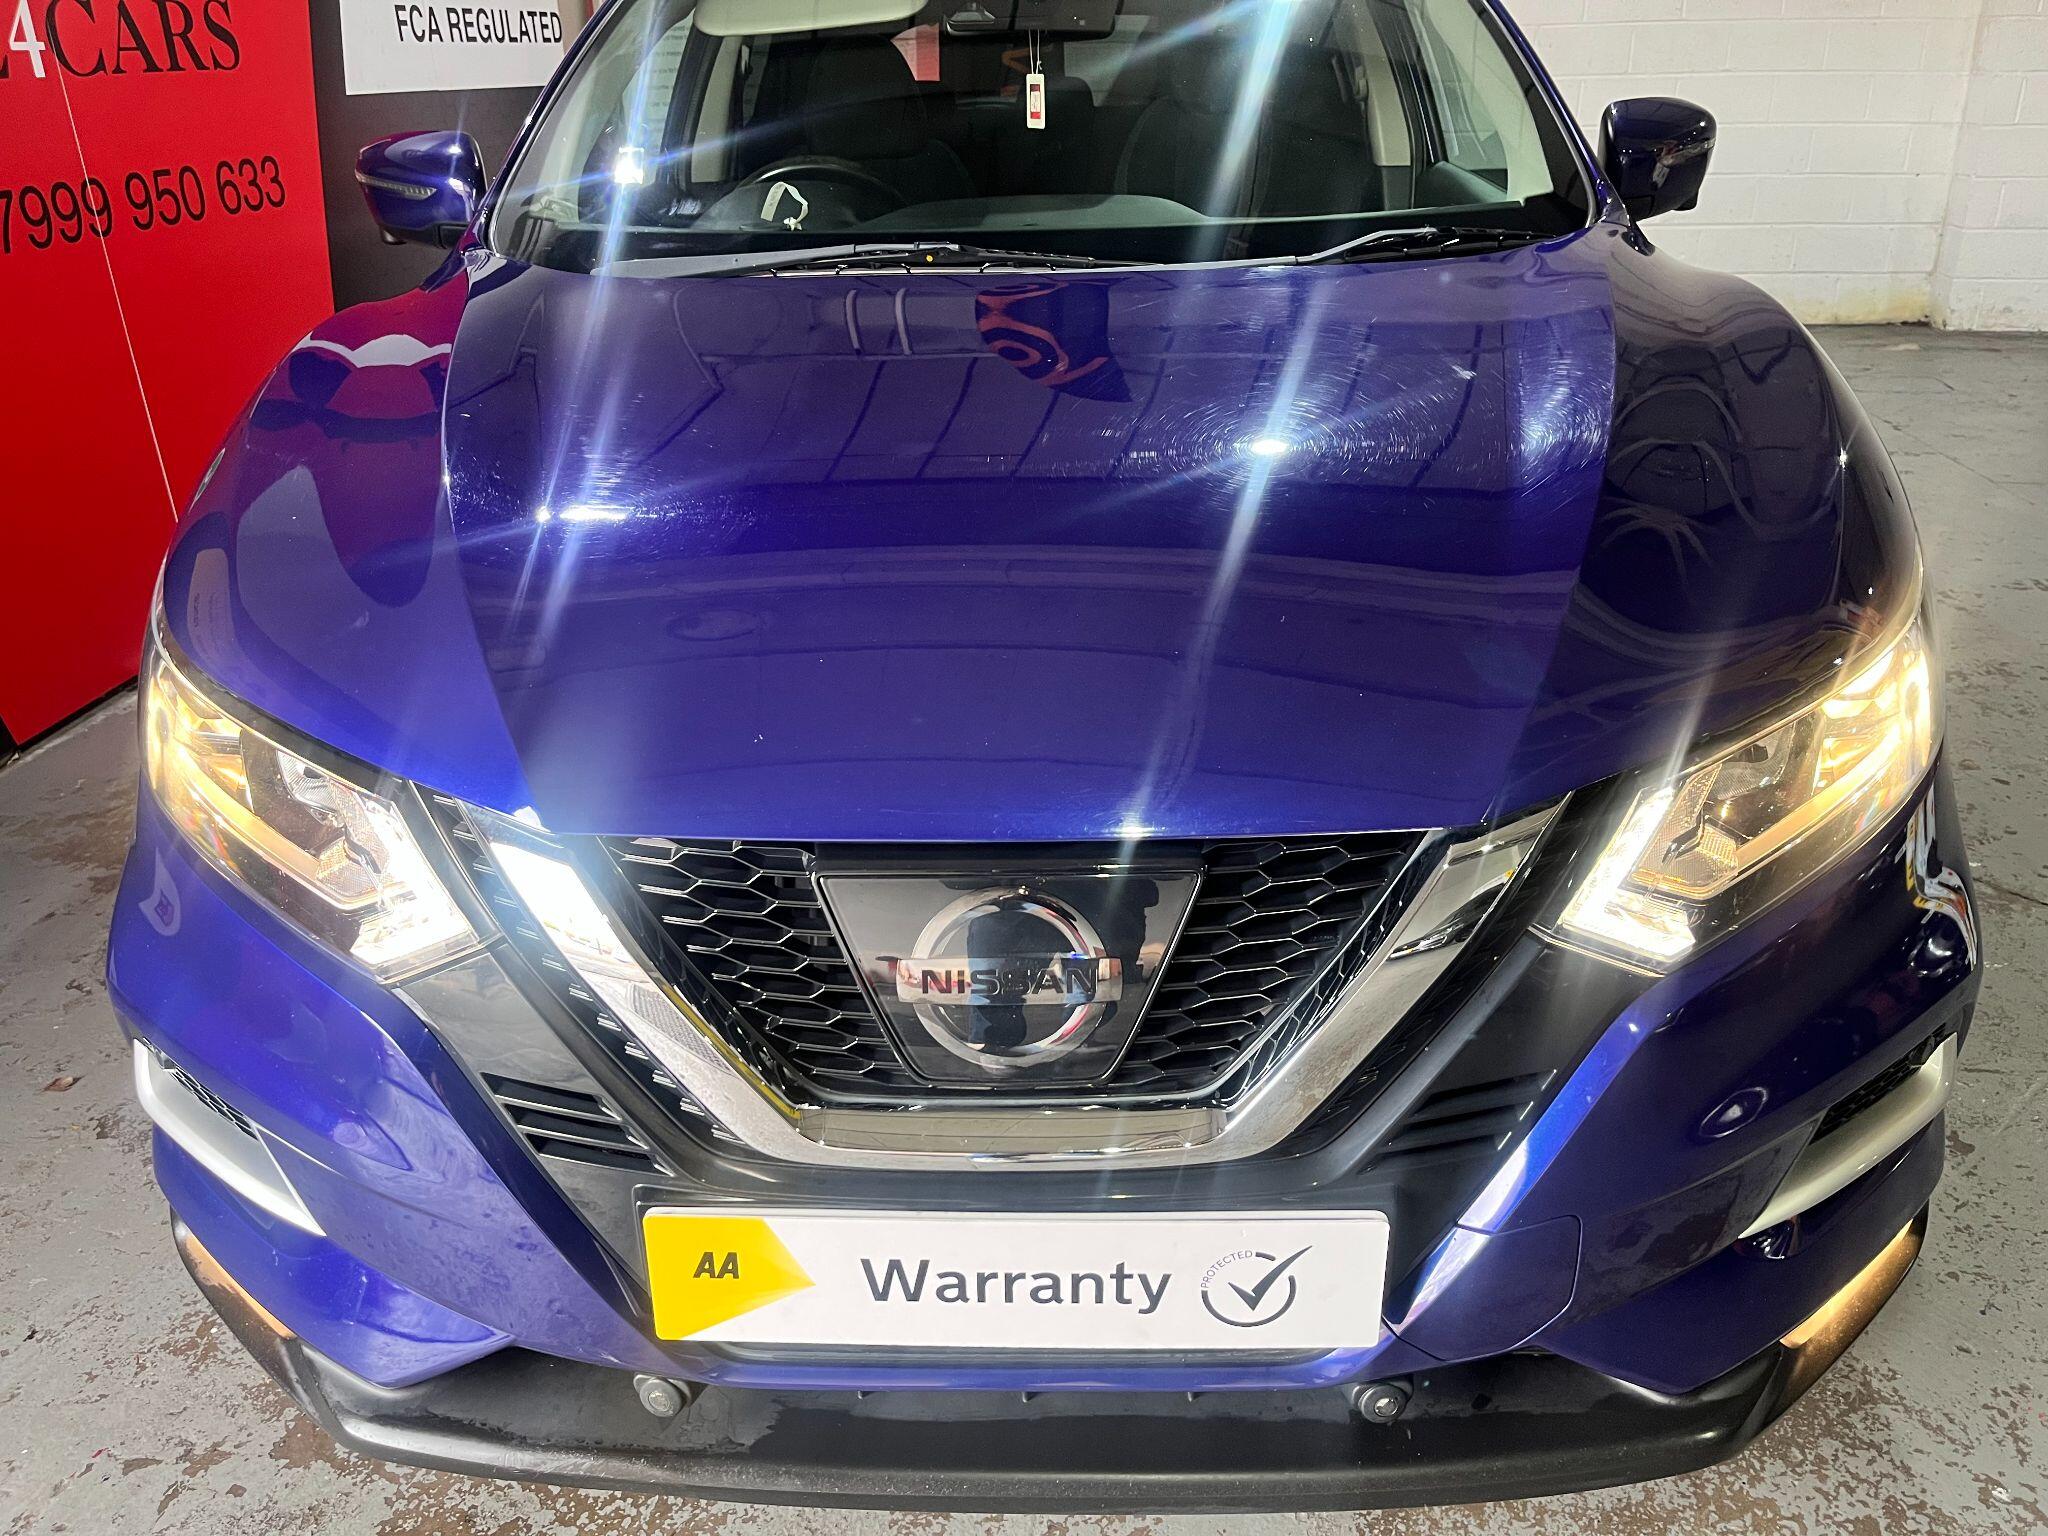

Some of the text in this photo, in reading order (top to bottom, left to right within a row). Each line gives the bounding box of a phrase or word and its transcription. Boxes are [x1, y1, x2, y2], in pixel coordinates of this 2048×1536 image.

[0, 0, 240, 79] 4CARS
[394, 4, 563, 44] FCA REGULATED
[124, 165, 206, 231] 950
[215, 155, 286, 215] 633
[920, 968, 1099, 996] NISSAN
[693, 1251, 1172, 1315] AA Warranty
[1200, 1249, 1253, 1289] PROTECTED
